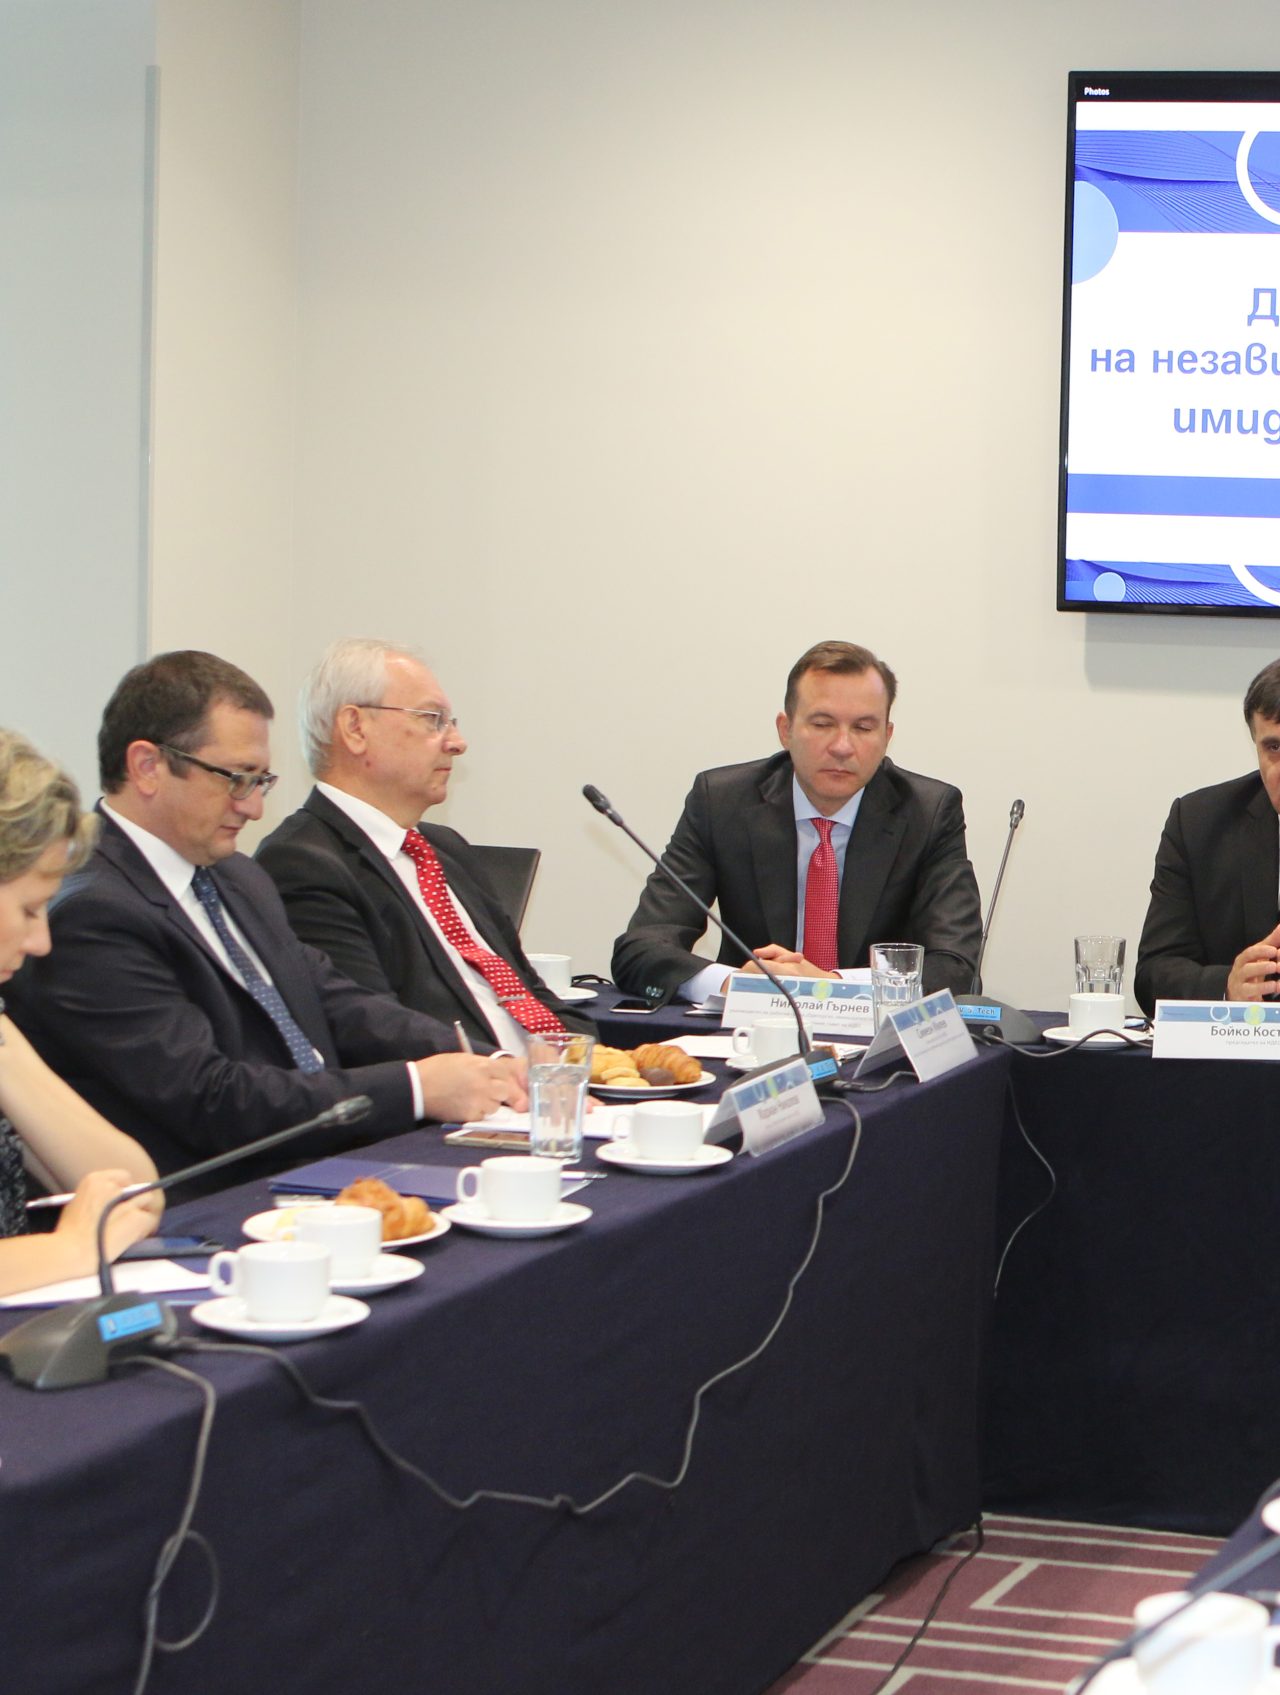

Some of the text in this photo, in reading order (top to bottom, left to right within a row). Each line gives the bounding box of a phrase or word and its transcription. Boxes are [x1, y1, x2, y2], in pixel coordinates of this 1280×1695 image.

[1084, 86, 1110, 96] Photos
[1090, 348, 1136, 374] на
[826, 1001, 871, 1014] Гърнев
[977, 1007, 995, 1015] Tech
[1210, 1025, 1250, 1037] Бойко
